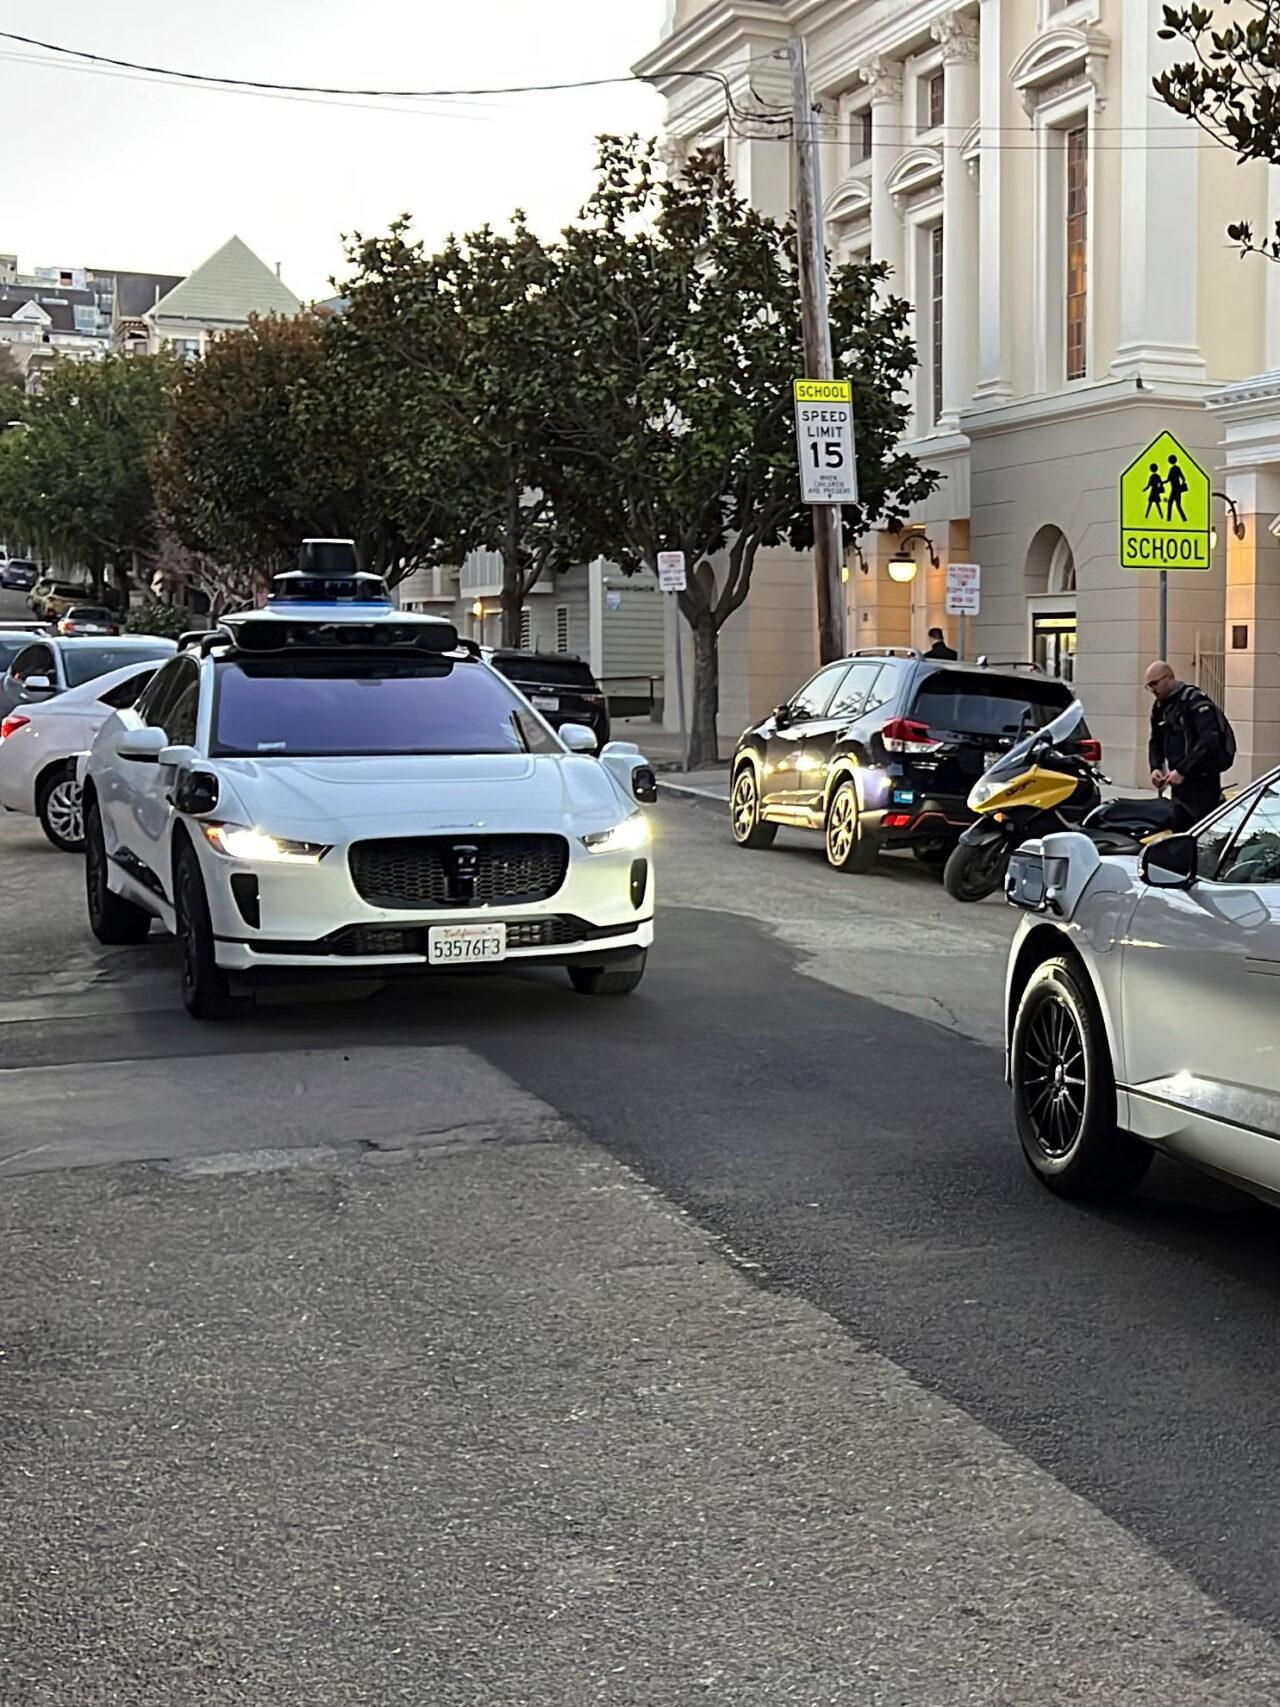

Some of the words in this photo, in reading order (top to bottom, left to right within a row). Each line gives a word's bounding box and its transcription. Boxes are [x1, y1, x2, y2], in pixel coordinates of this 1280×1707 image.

[798, 386, 847, 398] SCHOOL
[802, 411, 847, 422] SPEED
[807, 426, 843, 437] LIMIT
[810, 441, 843, 468] 15
[1127, 537, 1205, 560] SCHOOL
[434, 938, 500, 958] 53576F3
